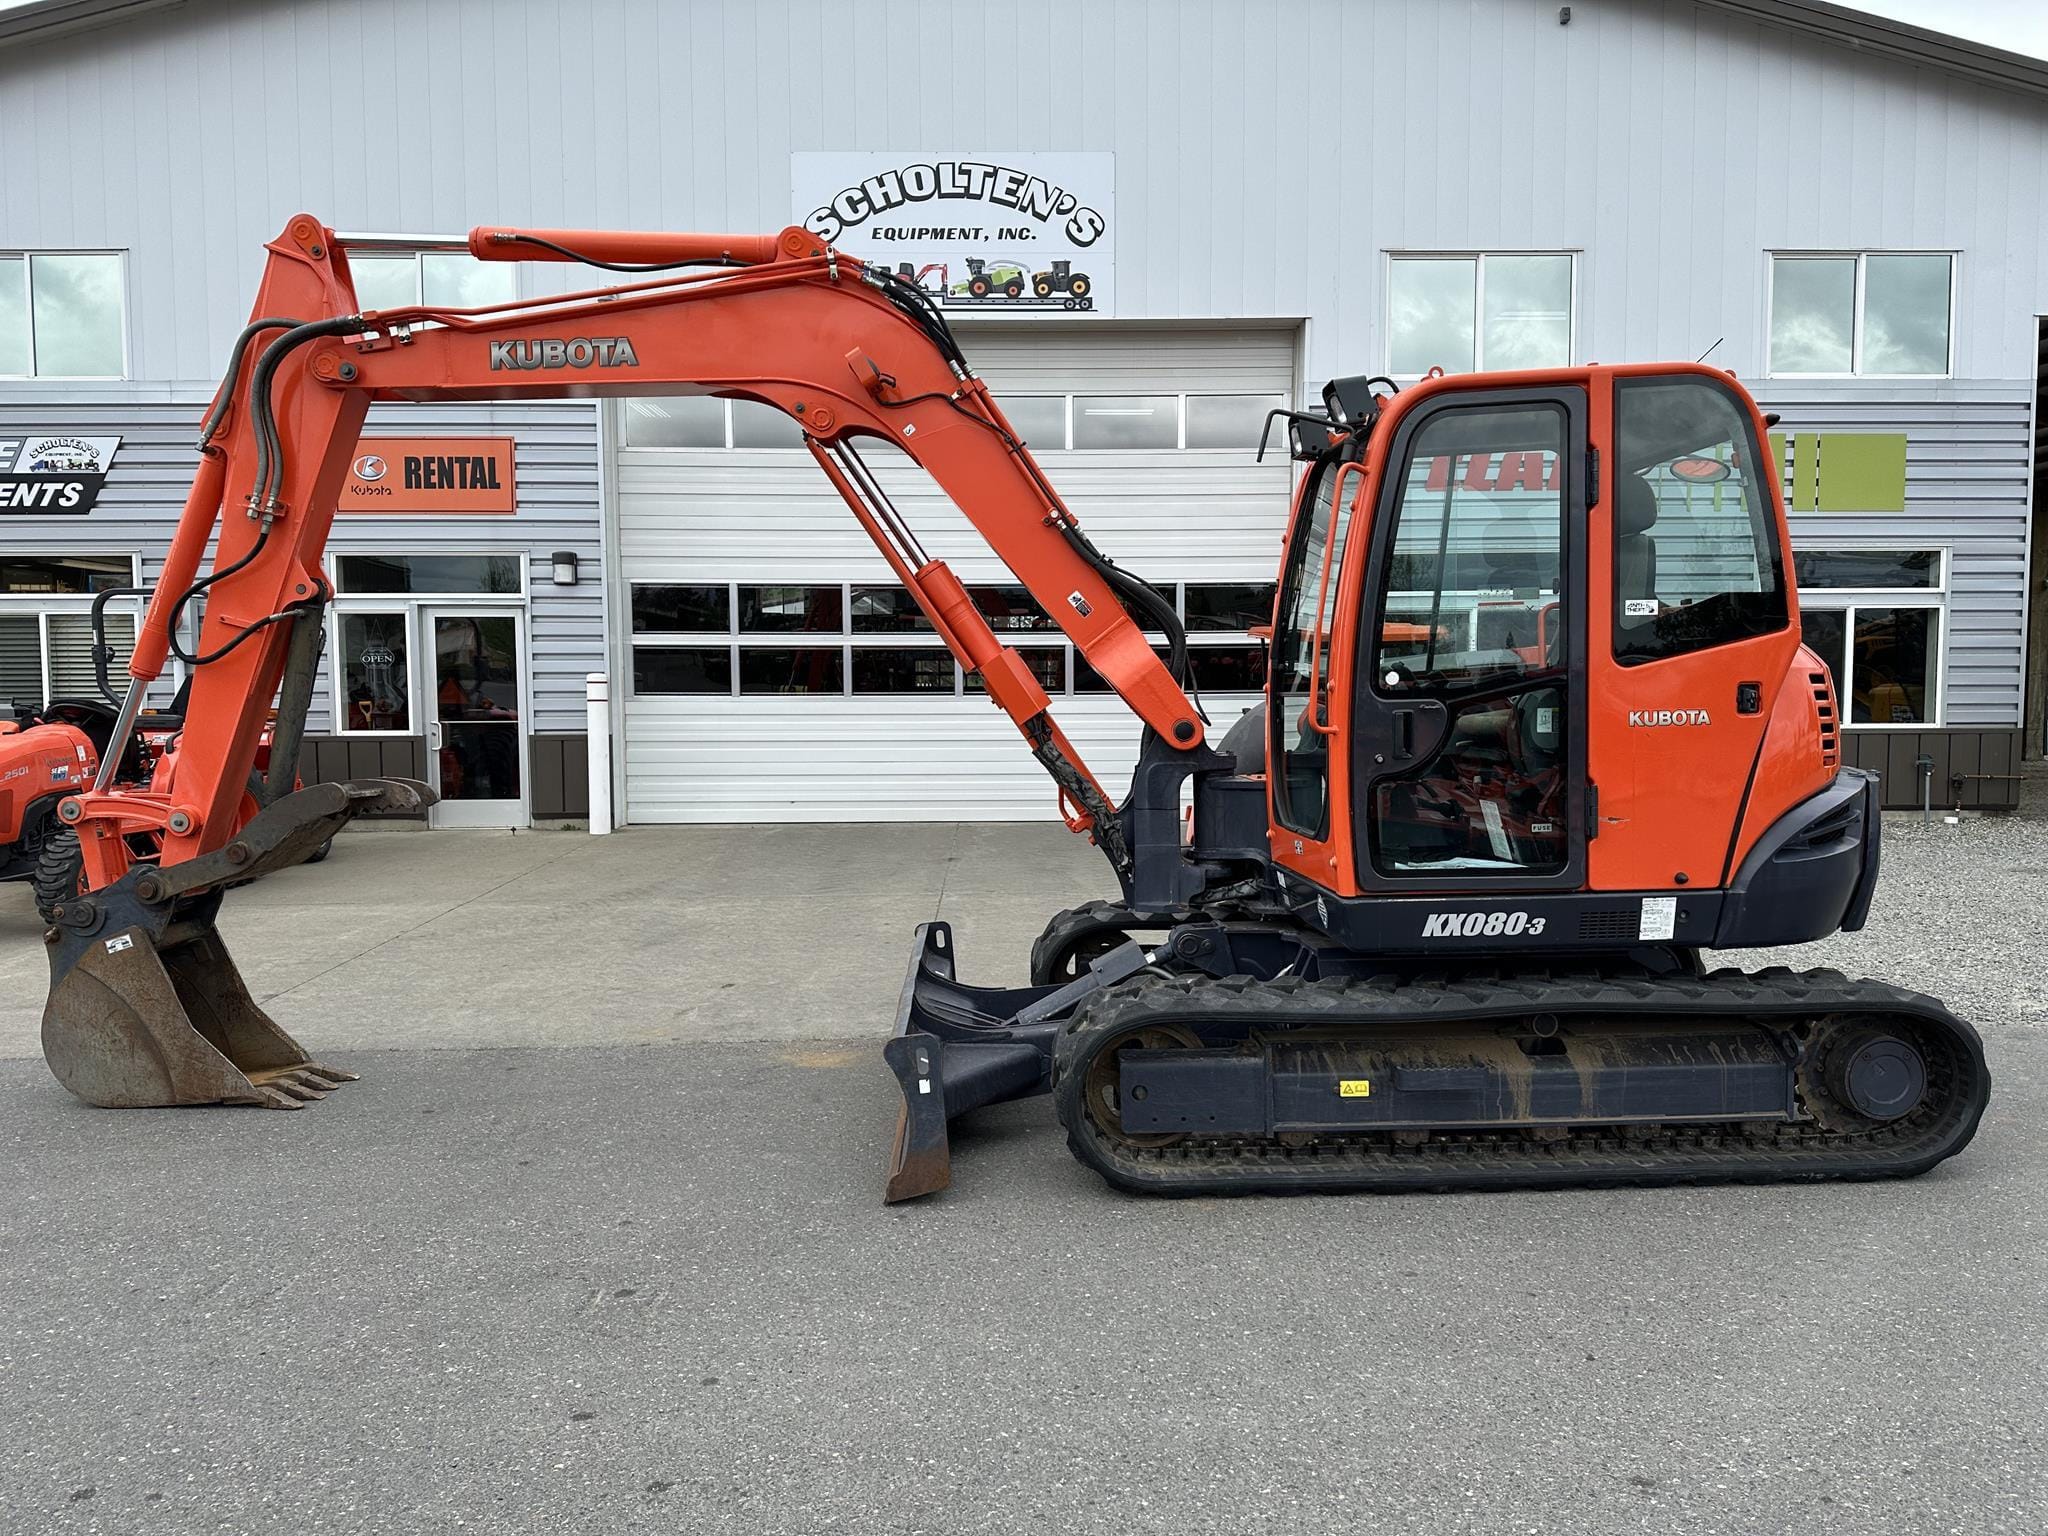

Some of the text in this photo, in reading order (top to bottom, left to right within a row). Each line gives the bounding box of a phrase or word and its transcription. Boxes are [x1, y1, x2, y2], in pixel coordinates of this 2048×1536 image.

[803, 162, 1105, 247] SCHOLTEN'S
[872, 227, 1037, 242] EQUIPMENT, INC.
[490, 337, 639, 370] KUBOTA
[29, 438, 100, 458] SCHOLTEN'S
[404, 456, 501, 489] RENTAL
[351, 485, 392, 495] Kubota
[1629, 710, 1711, 727] KUBOTA
[1422, 912, 1546, 937] KX080-3
